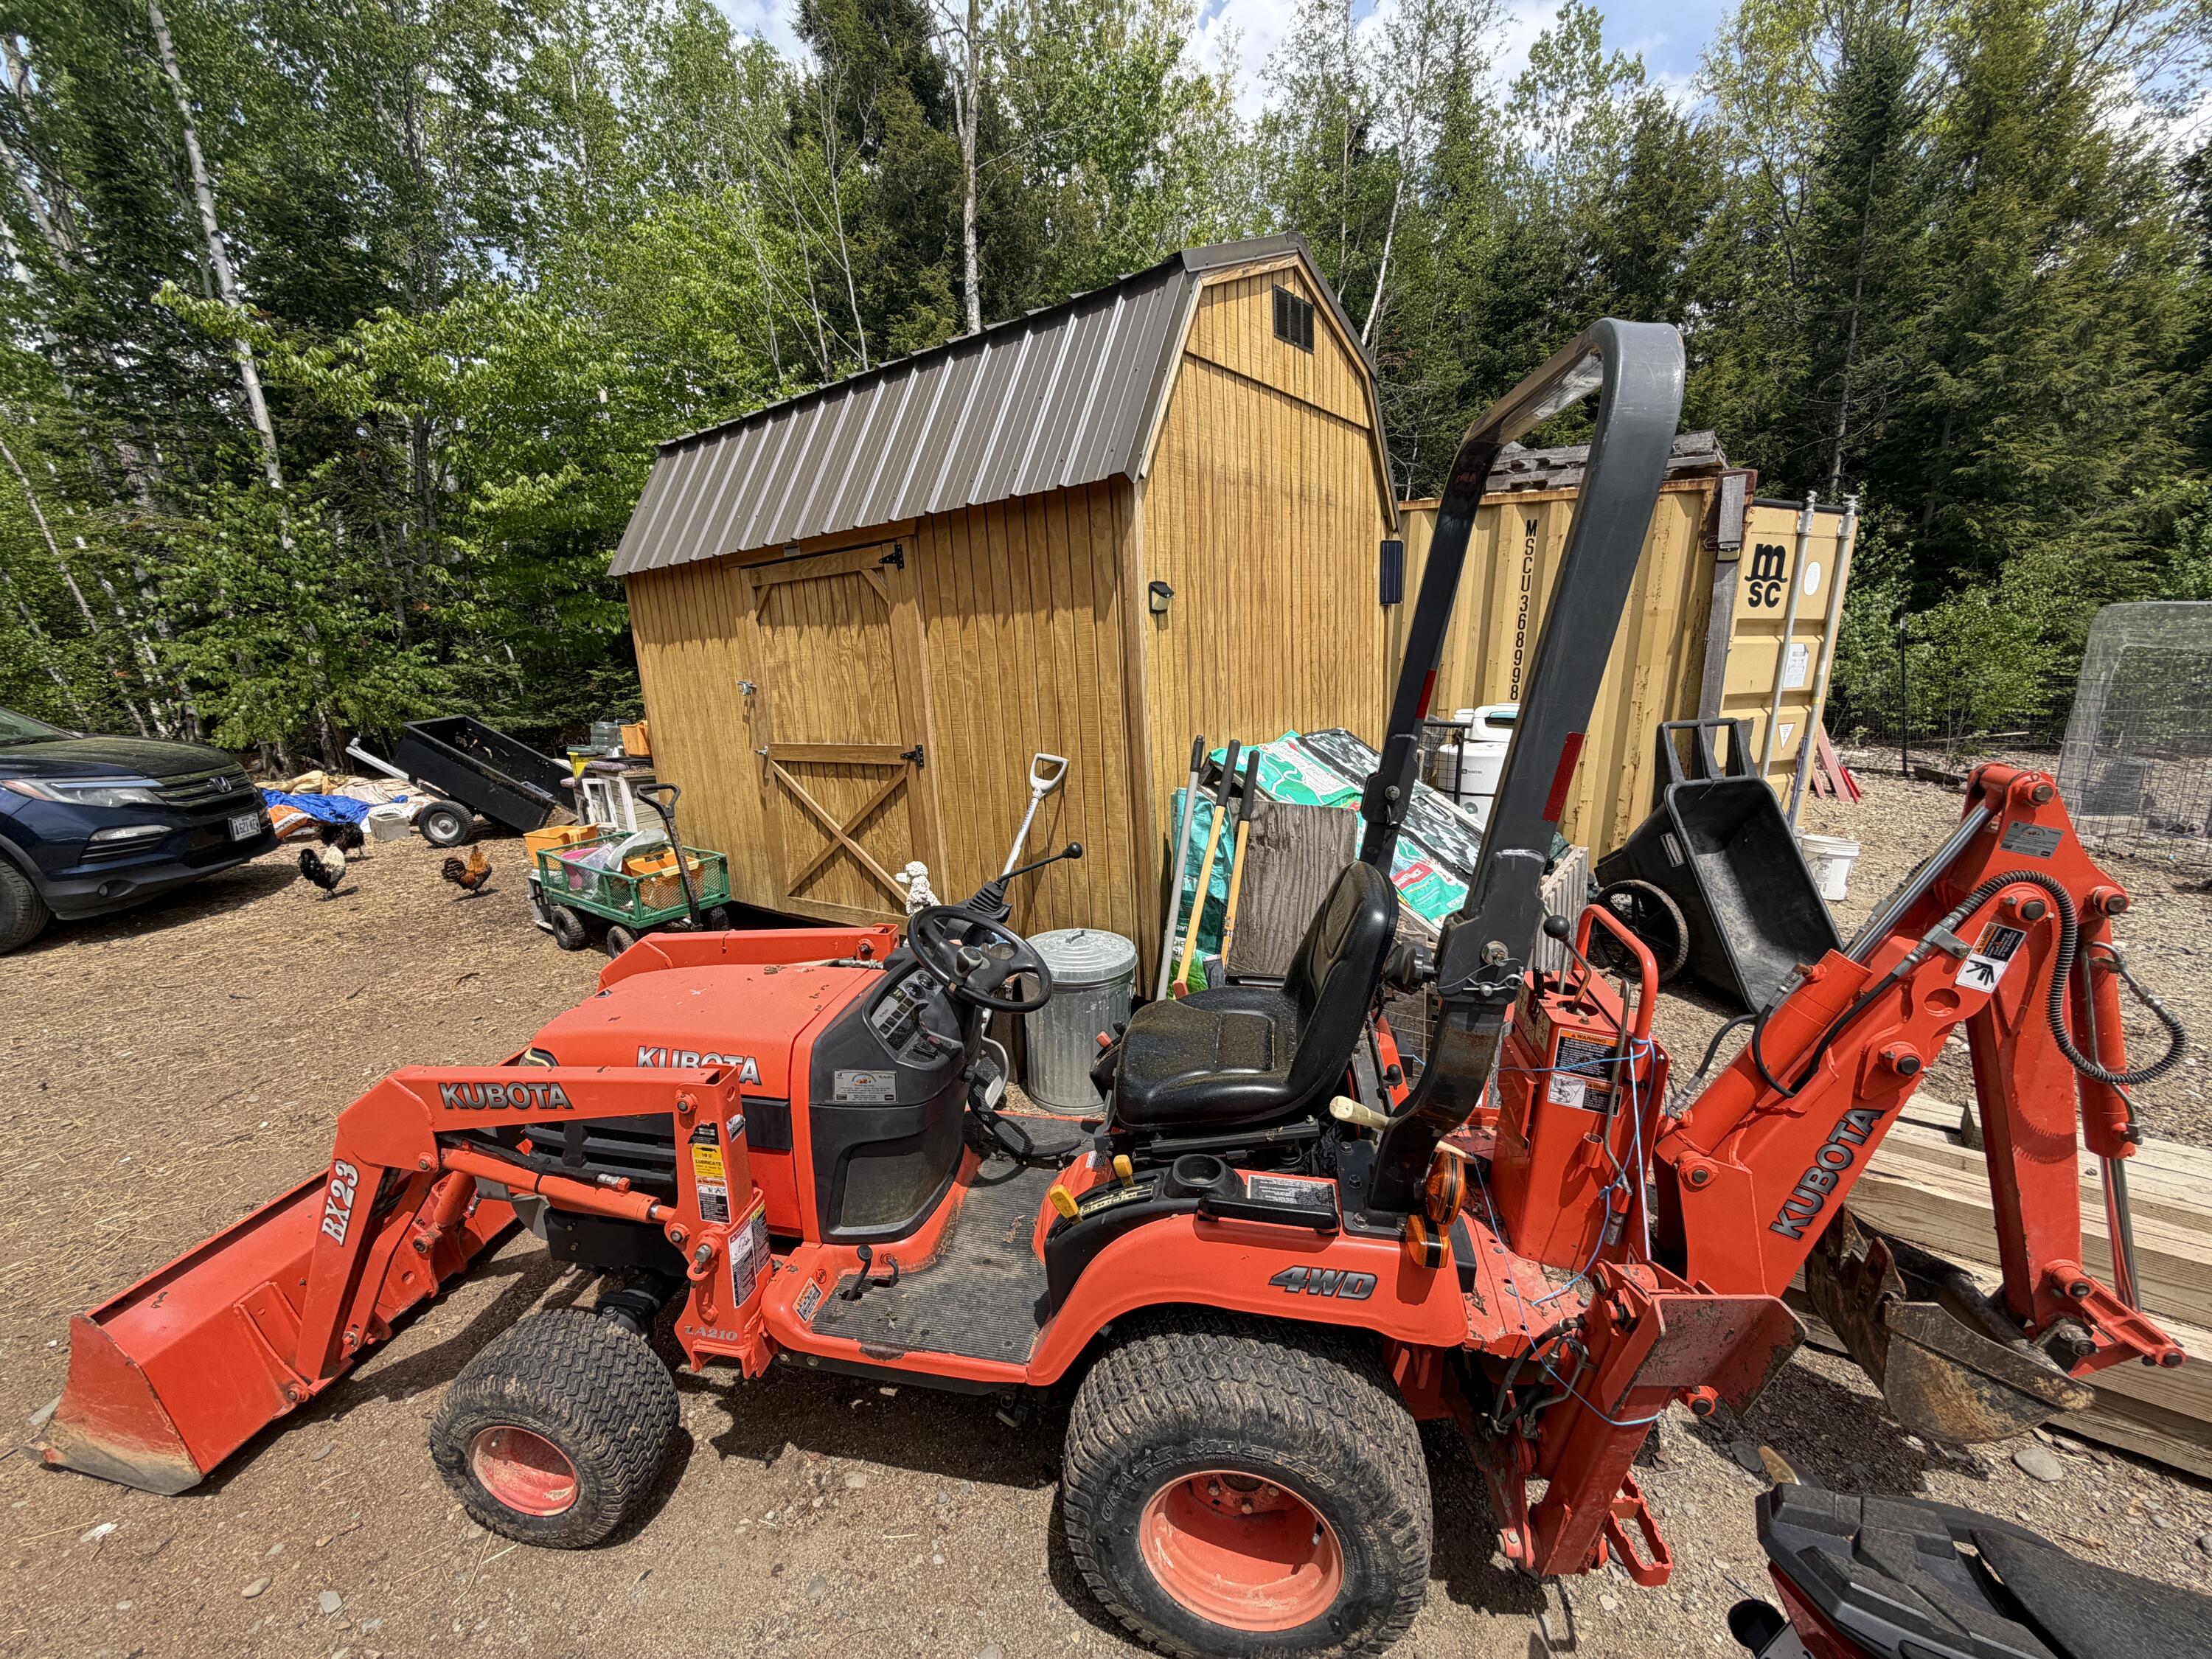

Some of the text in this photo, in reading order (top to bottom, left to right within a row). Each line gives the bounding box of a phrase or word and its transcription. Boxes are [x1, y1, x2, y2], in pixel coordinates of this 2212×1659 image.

[1576, 1034, 1607, 1044] WARNING
[438, 1081, 574, 1110] KUBOTA
[1769, 1108, 1886, 1242] KUBOTA
[321, 1158, 359, 1247] BX23
[1268, 1265, 1378, 1301] 4WD
[684, 1325, 738, 1341] LA210
[1101, 1439, 1336, 1522] GRASS MASTER
